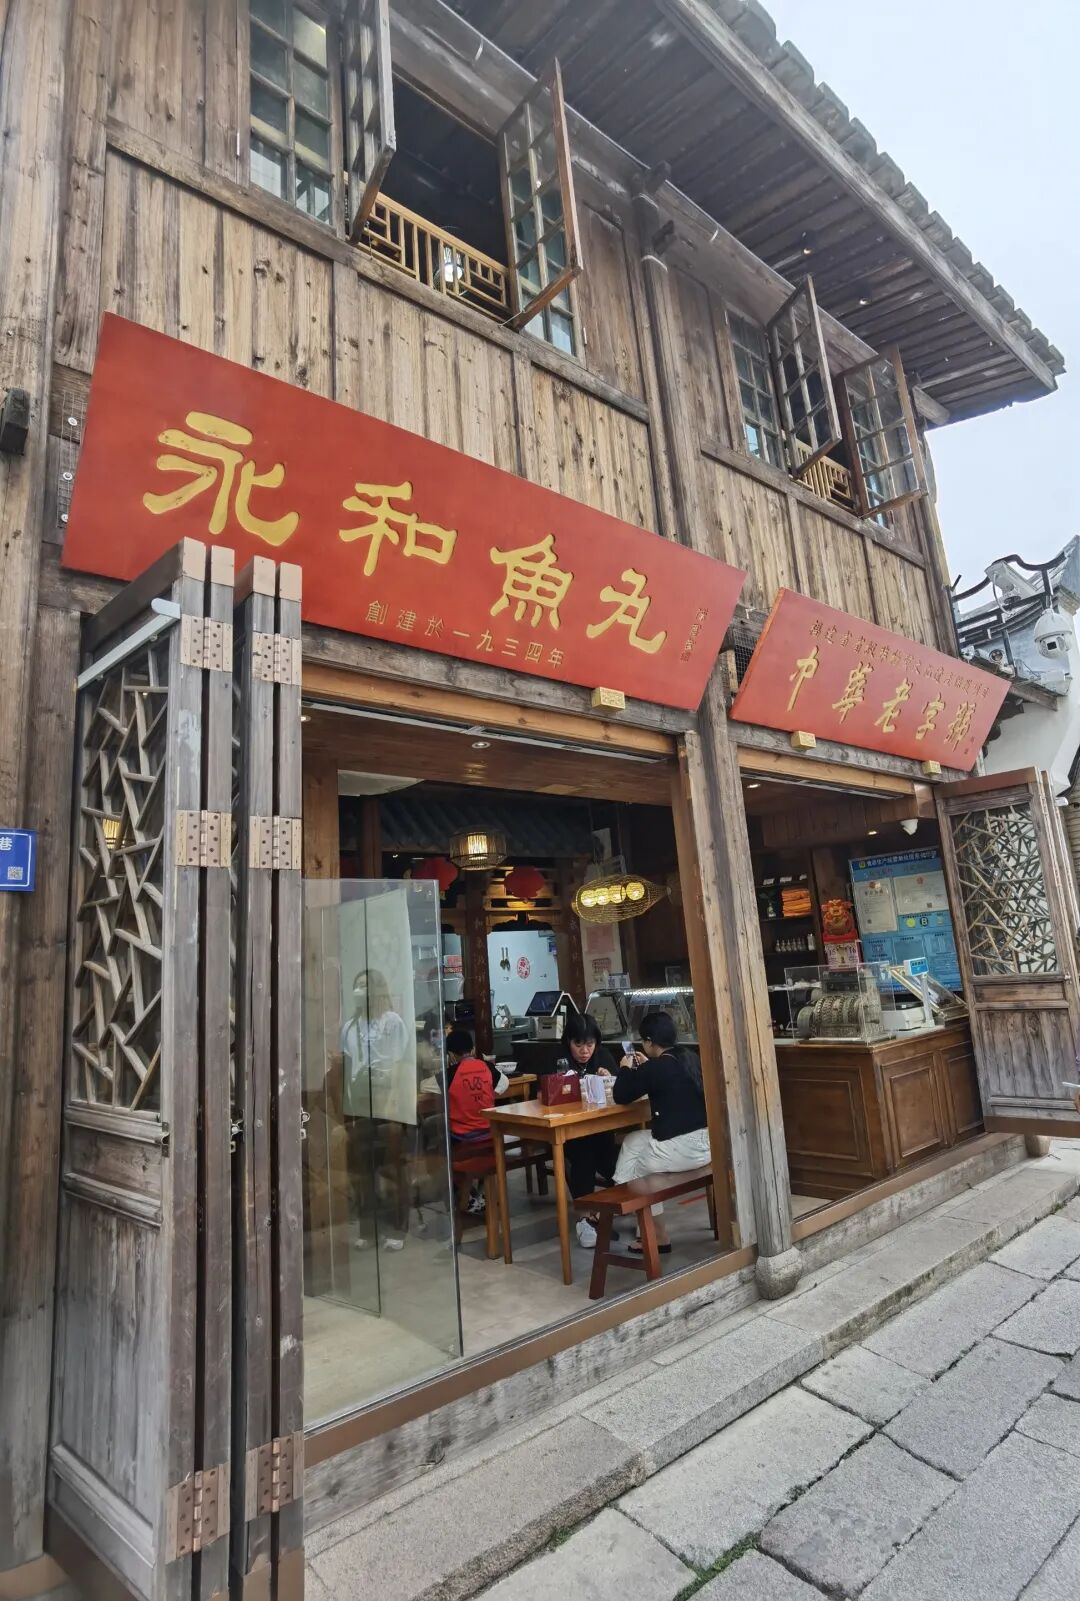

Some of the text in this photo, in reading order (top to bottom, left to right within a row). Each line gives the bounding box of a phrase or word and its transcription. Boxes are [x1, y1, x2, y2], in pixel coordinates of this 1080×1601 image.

[143, 411, 666, 655] 永和魚丸
[365, 600, 564, 668] 創建於一九三四年
